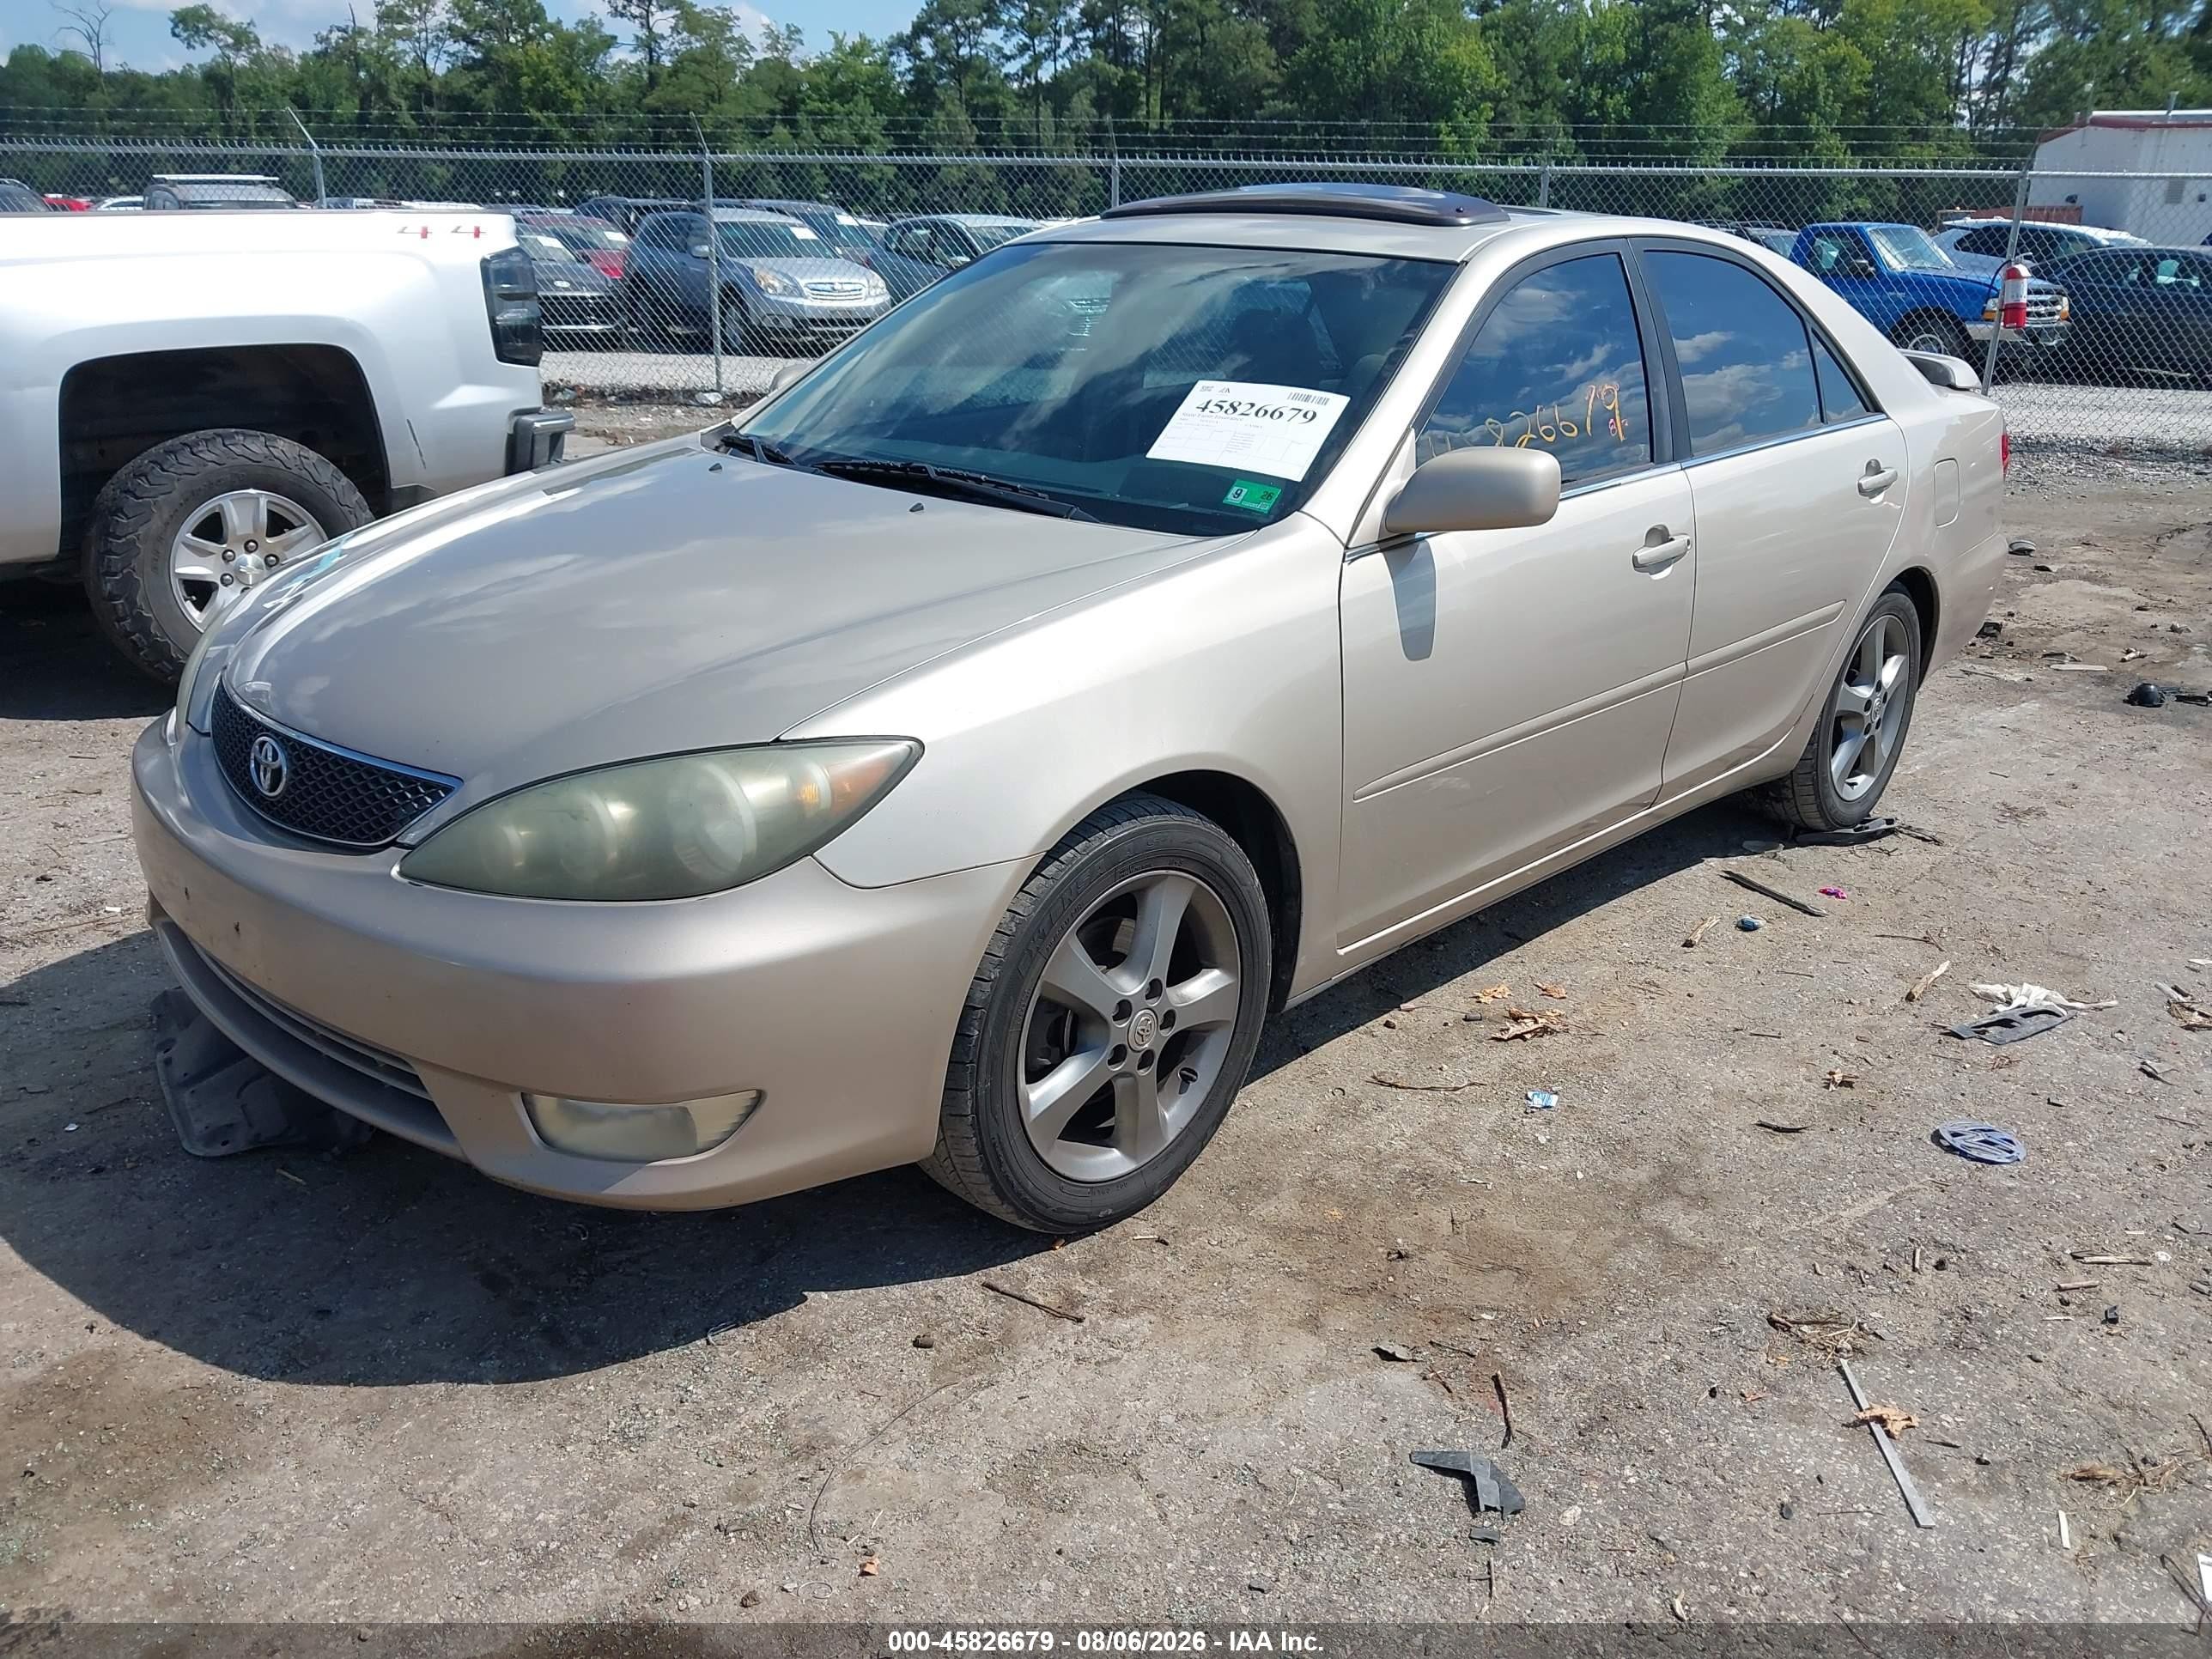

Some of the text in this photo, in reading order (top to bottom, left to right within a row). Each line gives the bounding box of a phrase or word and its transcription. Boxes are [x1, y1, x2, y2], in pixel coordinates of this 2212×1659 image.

[1195, 398, 1318, 425] 45826679
[1232, 489, 1275, 501] 9 26
